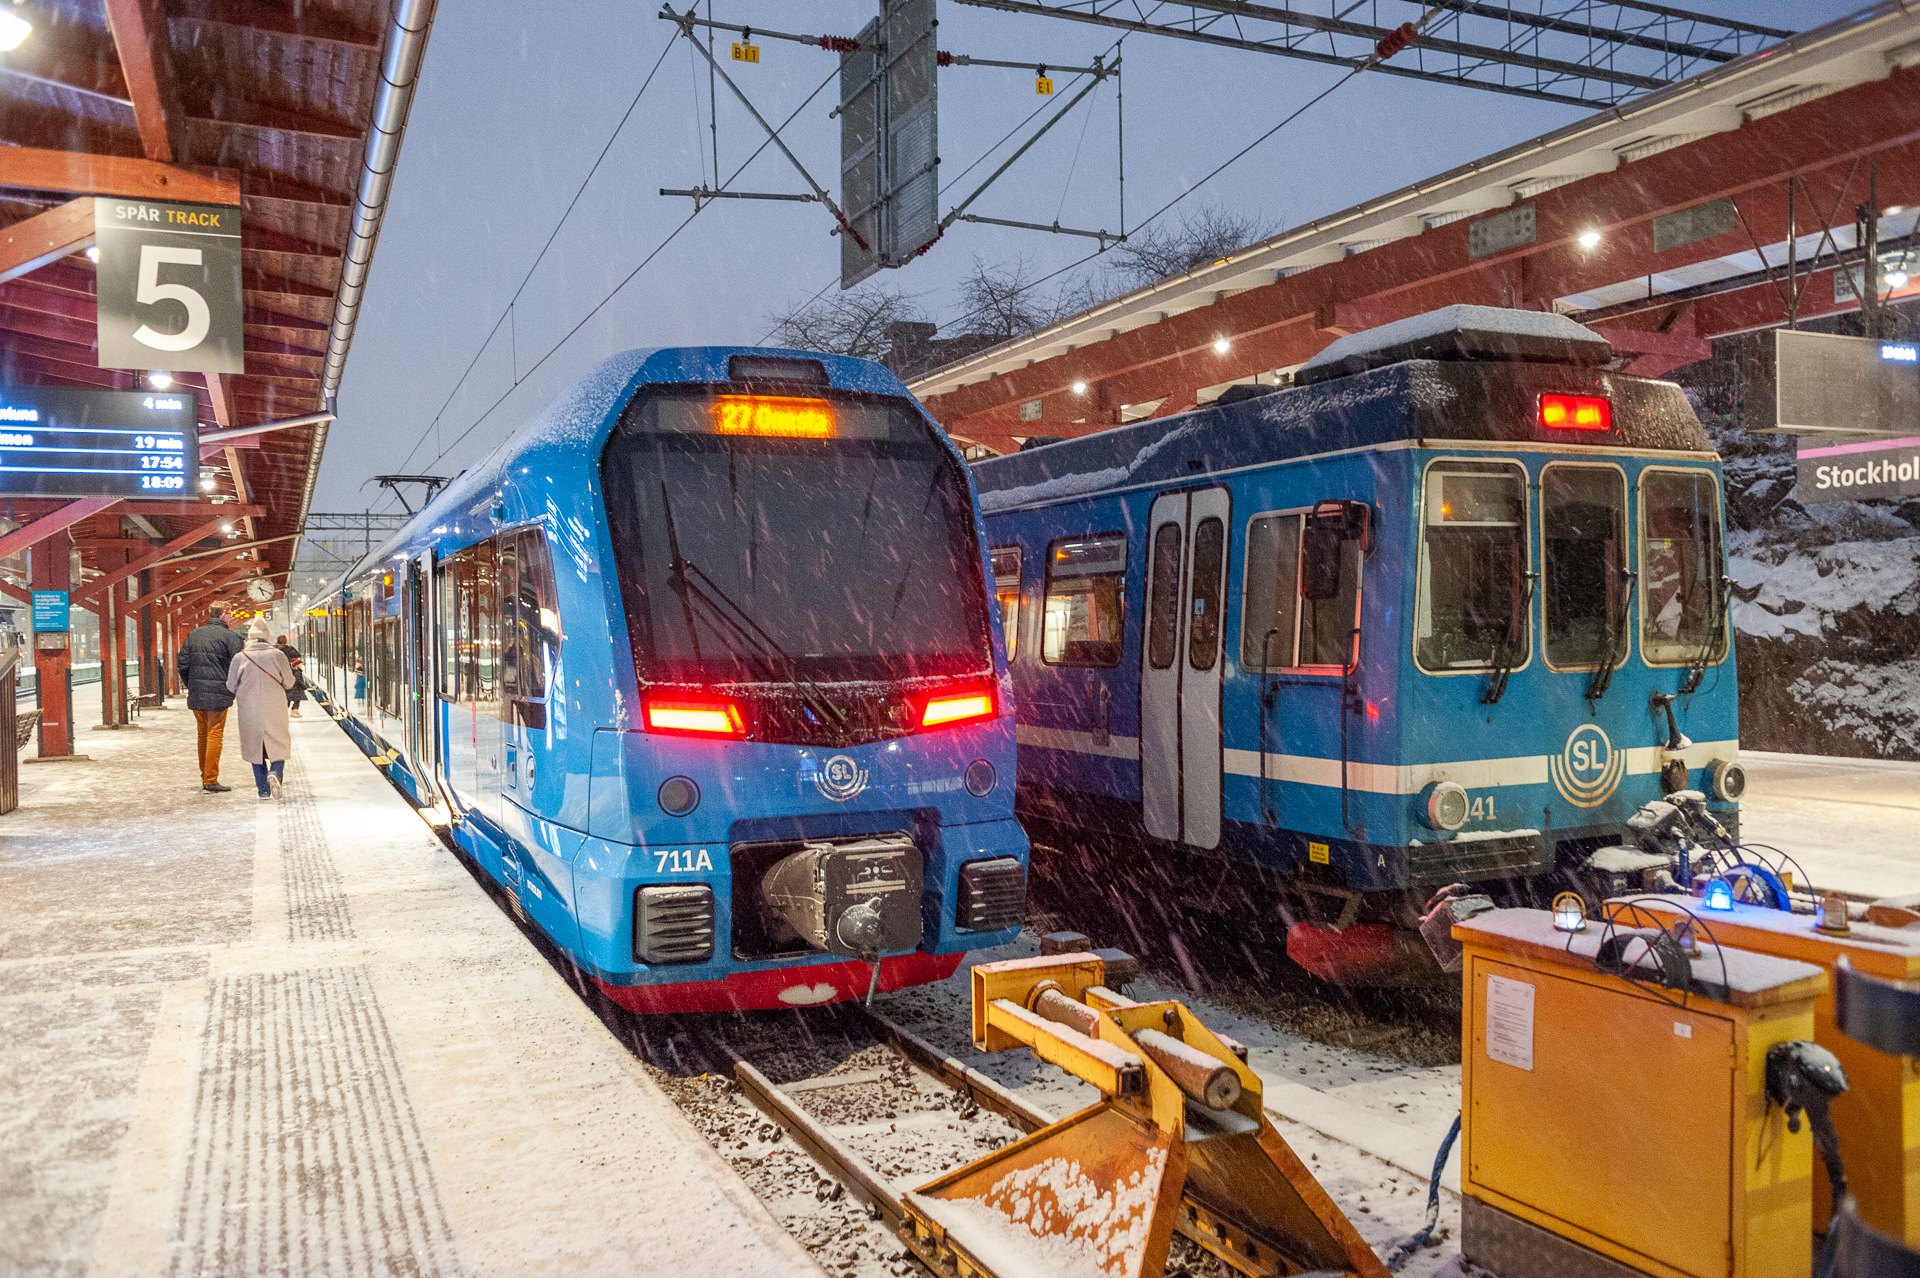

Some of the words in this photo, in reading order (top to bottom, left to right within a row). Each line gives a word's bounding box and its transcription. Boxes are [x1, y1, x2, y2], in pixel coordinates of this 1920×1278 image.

[115, 205, 160, 222] SPÅR
[165, 210, 220, 227] TRACK
[132, 245, 211, 352] 5
[143, 396, 155, 409] 4
[135, 435, 156, 449] 19
[141, 456, 184, 469] 17:54
[1816, 456, 1920, 489] Stockhol
[141, 475, 184, 489] 18:09
[265, 612, 272, 621] 5
[1573, 739, 1605, 772] SL
[831, 763, 852, 781] SL
[653, 849, 714, 873] 711A
[1377, 853, 1386, 868] A
